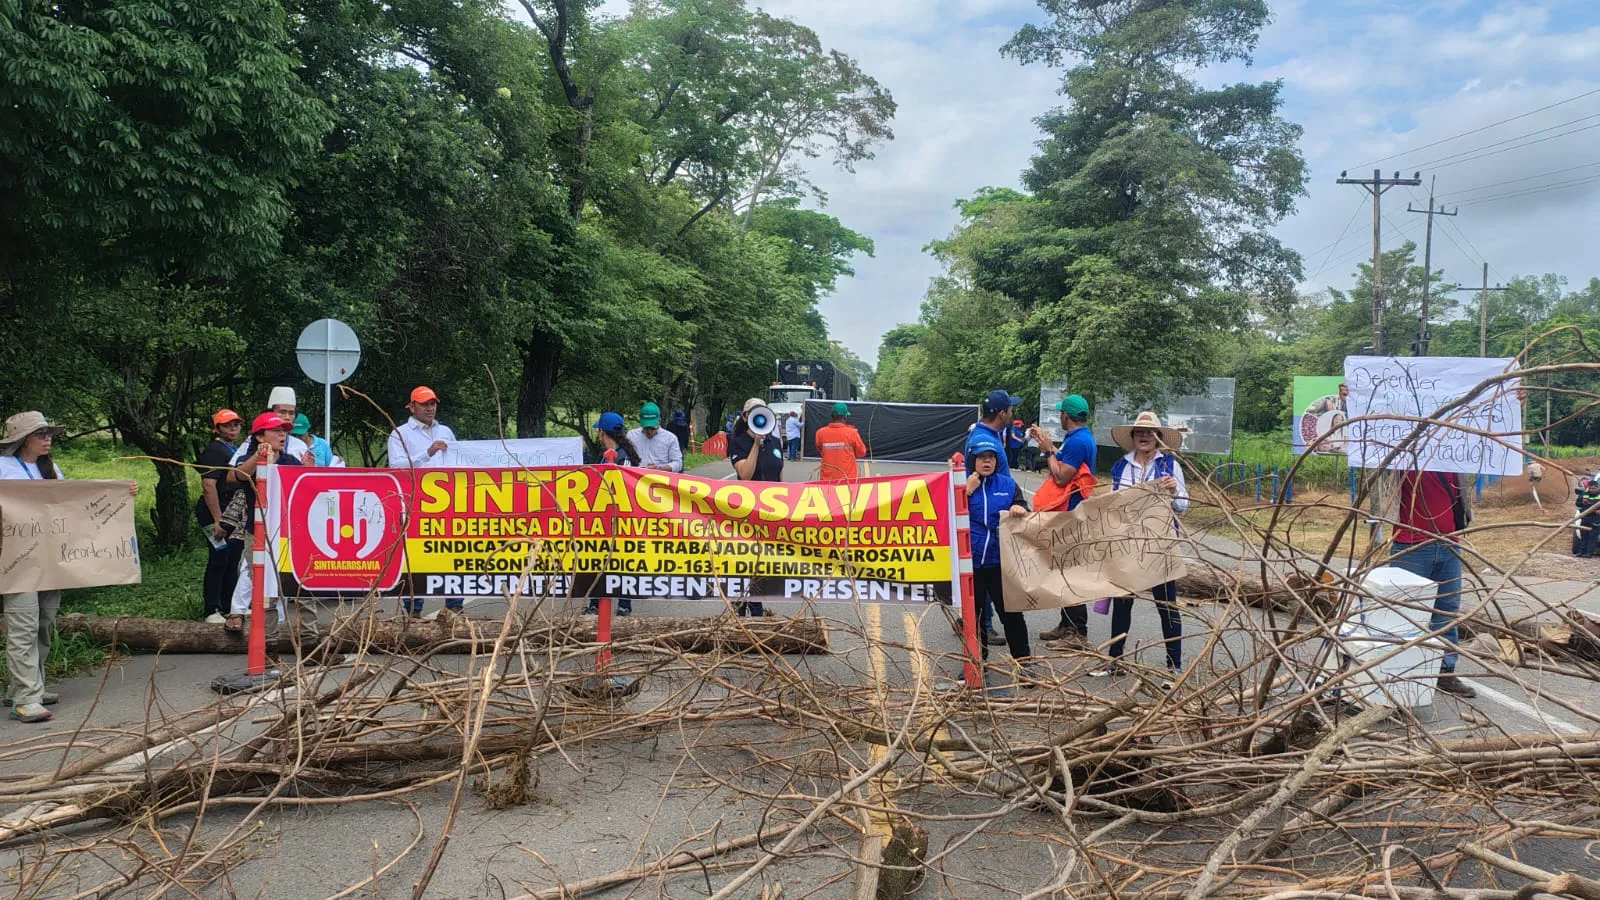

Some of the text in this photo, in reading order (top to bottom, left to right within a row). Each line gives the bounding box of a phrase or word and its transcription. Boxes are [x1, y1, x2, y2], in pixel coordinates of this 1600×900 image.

[1353, 366, 1441, 391] Defender
[420, 469, 937, 522] SINTRAGROSAVIA
[419, 517, 445, 536] EN
[452, 517, 543, 536] DEFENSA
[549, 517, 573, 536] DE
[580, 517, 605, 536] LA
[776, 525, 938, 545] AGROPECUARIA
[61, 540, 112, 563] Recortes
[424, 540, 521, 553] SINDICATO
[624, 540, 646, 553] DE
[652, 541, 795, 556] TRABAJADORES
[801, 546, 822, 557] DE
[828, 548, 934, 562] AGROSAVIA
[314, 560, 380, 570] SINTRAGROSAVIA
[569, 554, 648, 572] JURÍDICA
[654, 559, 728, 574] JD-163-1
[736, 561, 832, 575] DICIEMBRE
[426, 575, 933, 601] PRESENTE! PRESENTE! PRESENTE!
